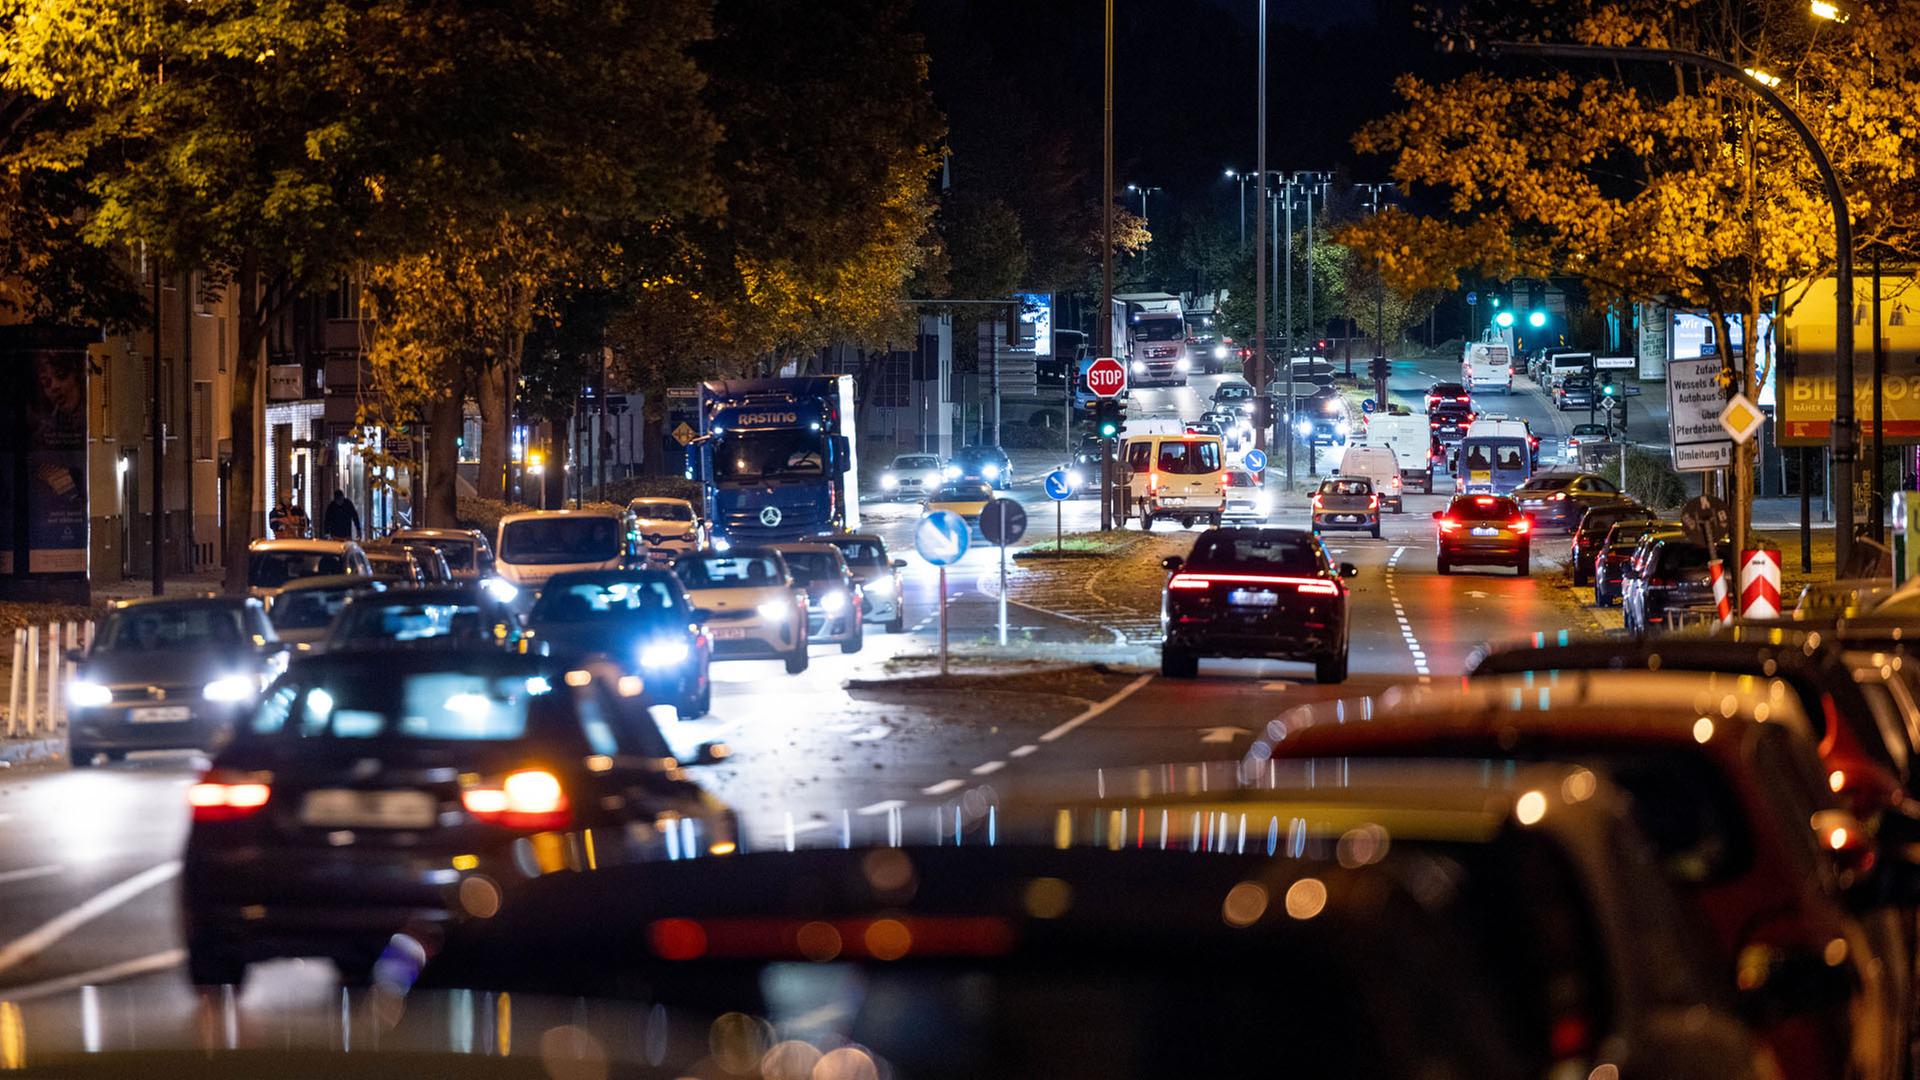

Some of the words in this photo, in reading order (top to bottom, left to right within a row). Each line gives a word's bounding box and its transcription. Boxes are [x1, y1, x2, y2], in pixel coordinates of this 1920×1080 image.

[1696, 364, 1721, 375] Zufahr
[1091, 370, 1122, 386] STOP
[1674, 379, 1707, 391] Wessels
[1794, 376, 1920, 400] BILAO?
[1679, 391, 1716, 404] Autohaus
[738, 412, 797, 425] RASTING
[1676, 423, 1726, 436] Pferdebahn
[1678, 449, 1720, 461] Umleitung
